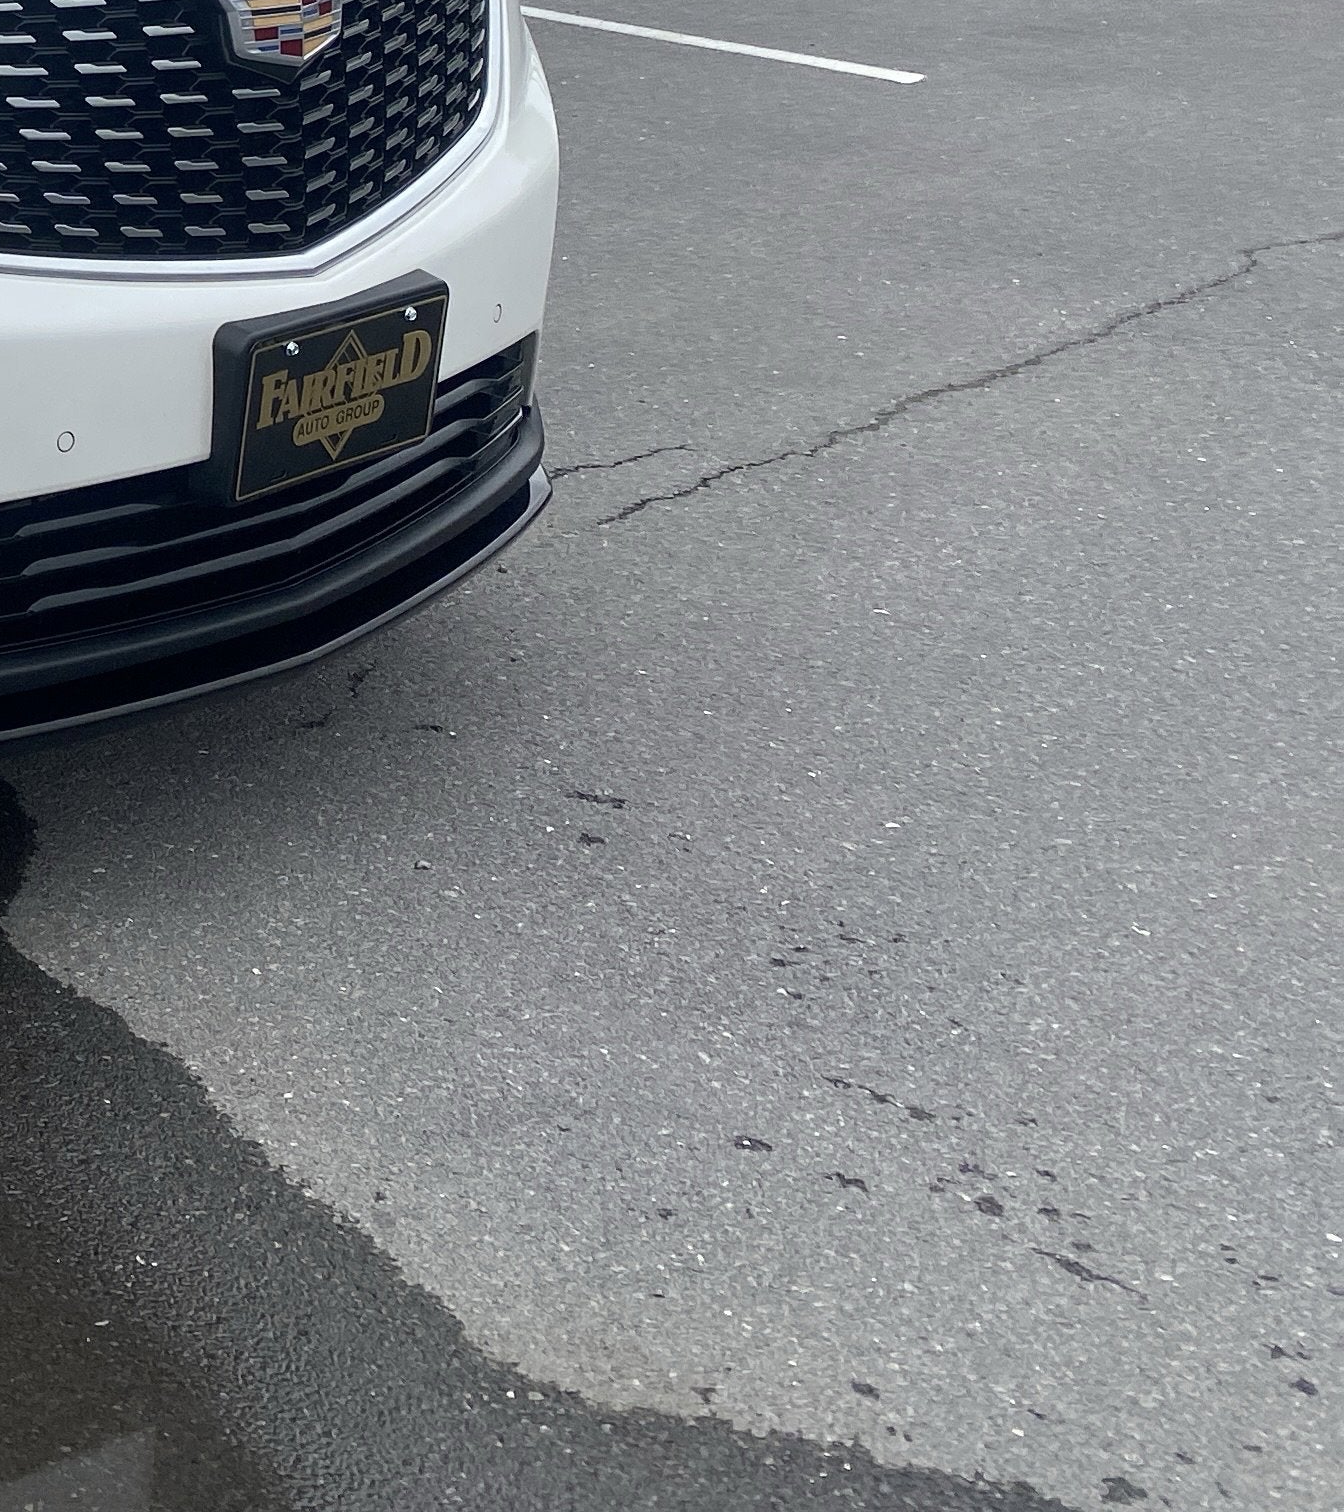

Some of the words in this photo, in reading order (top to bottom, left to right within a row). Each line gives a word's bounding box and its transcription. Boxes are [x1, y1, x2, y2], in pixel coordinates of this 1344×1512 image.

[256, 329, 433, 430] FAIRFIELD
[296, 414, 330, 438] AUTO
[335, 398, 380, 425] GROUP
